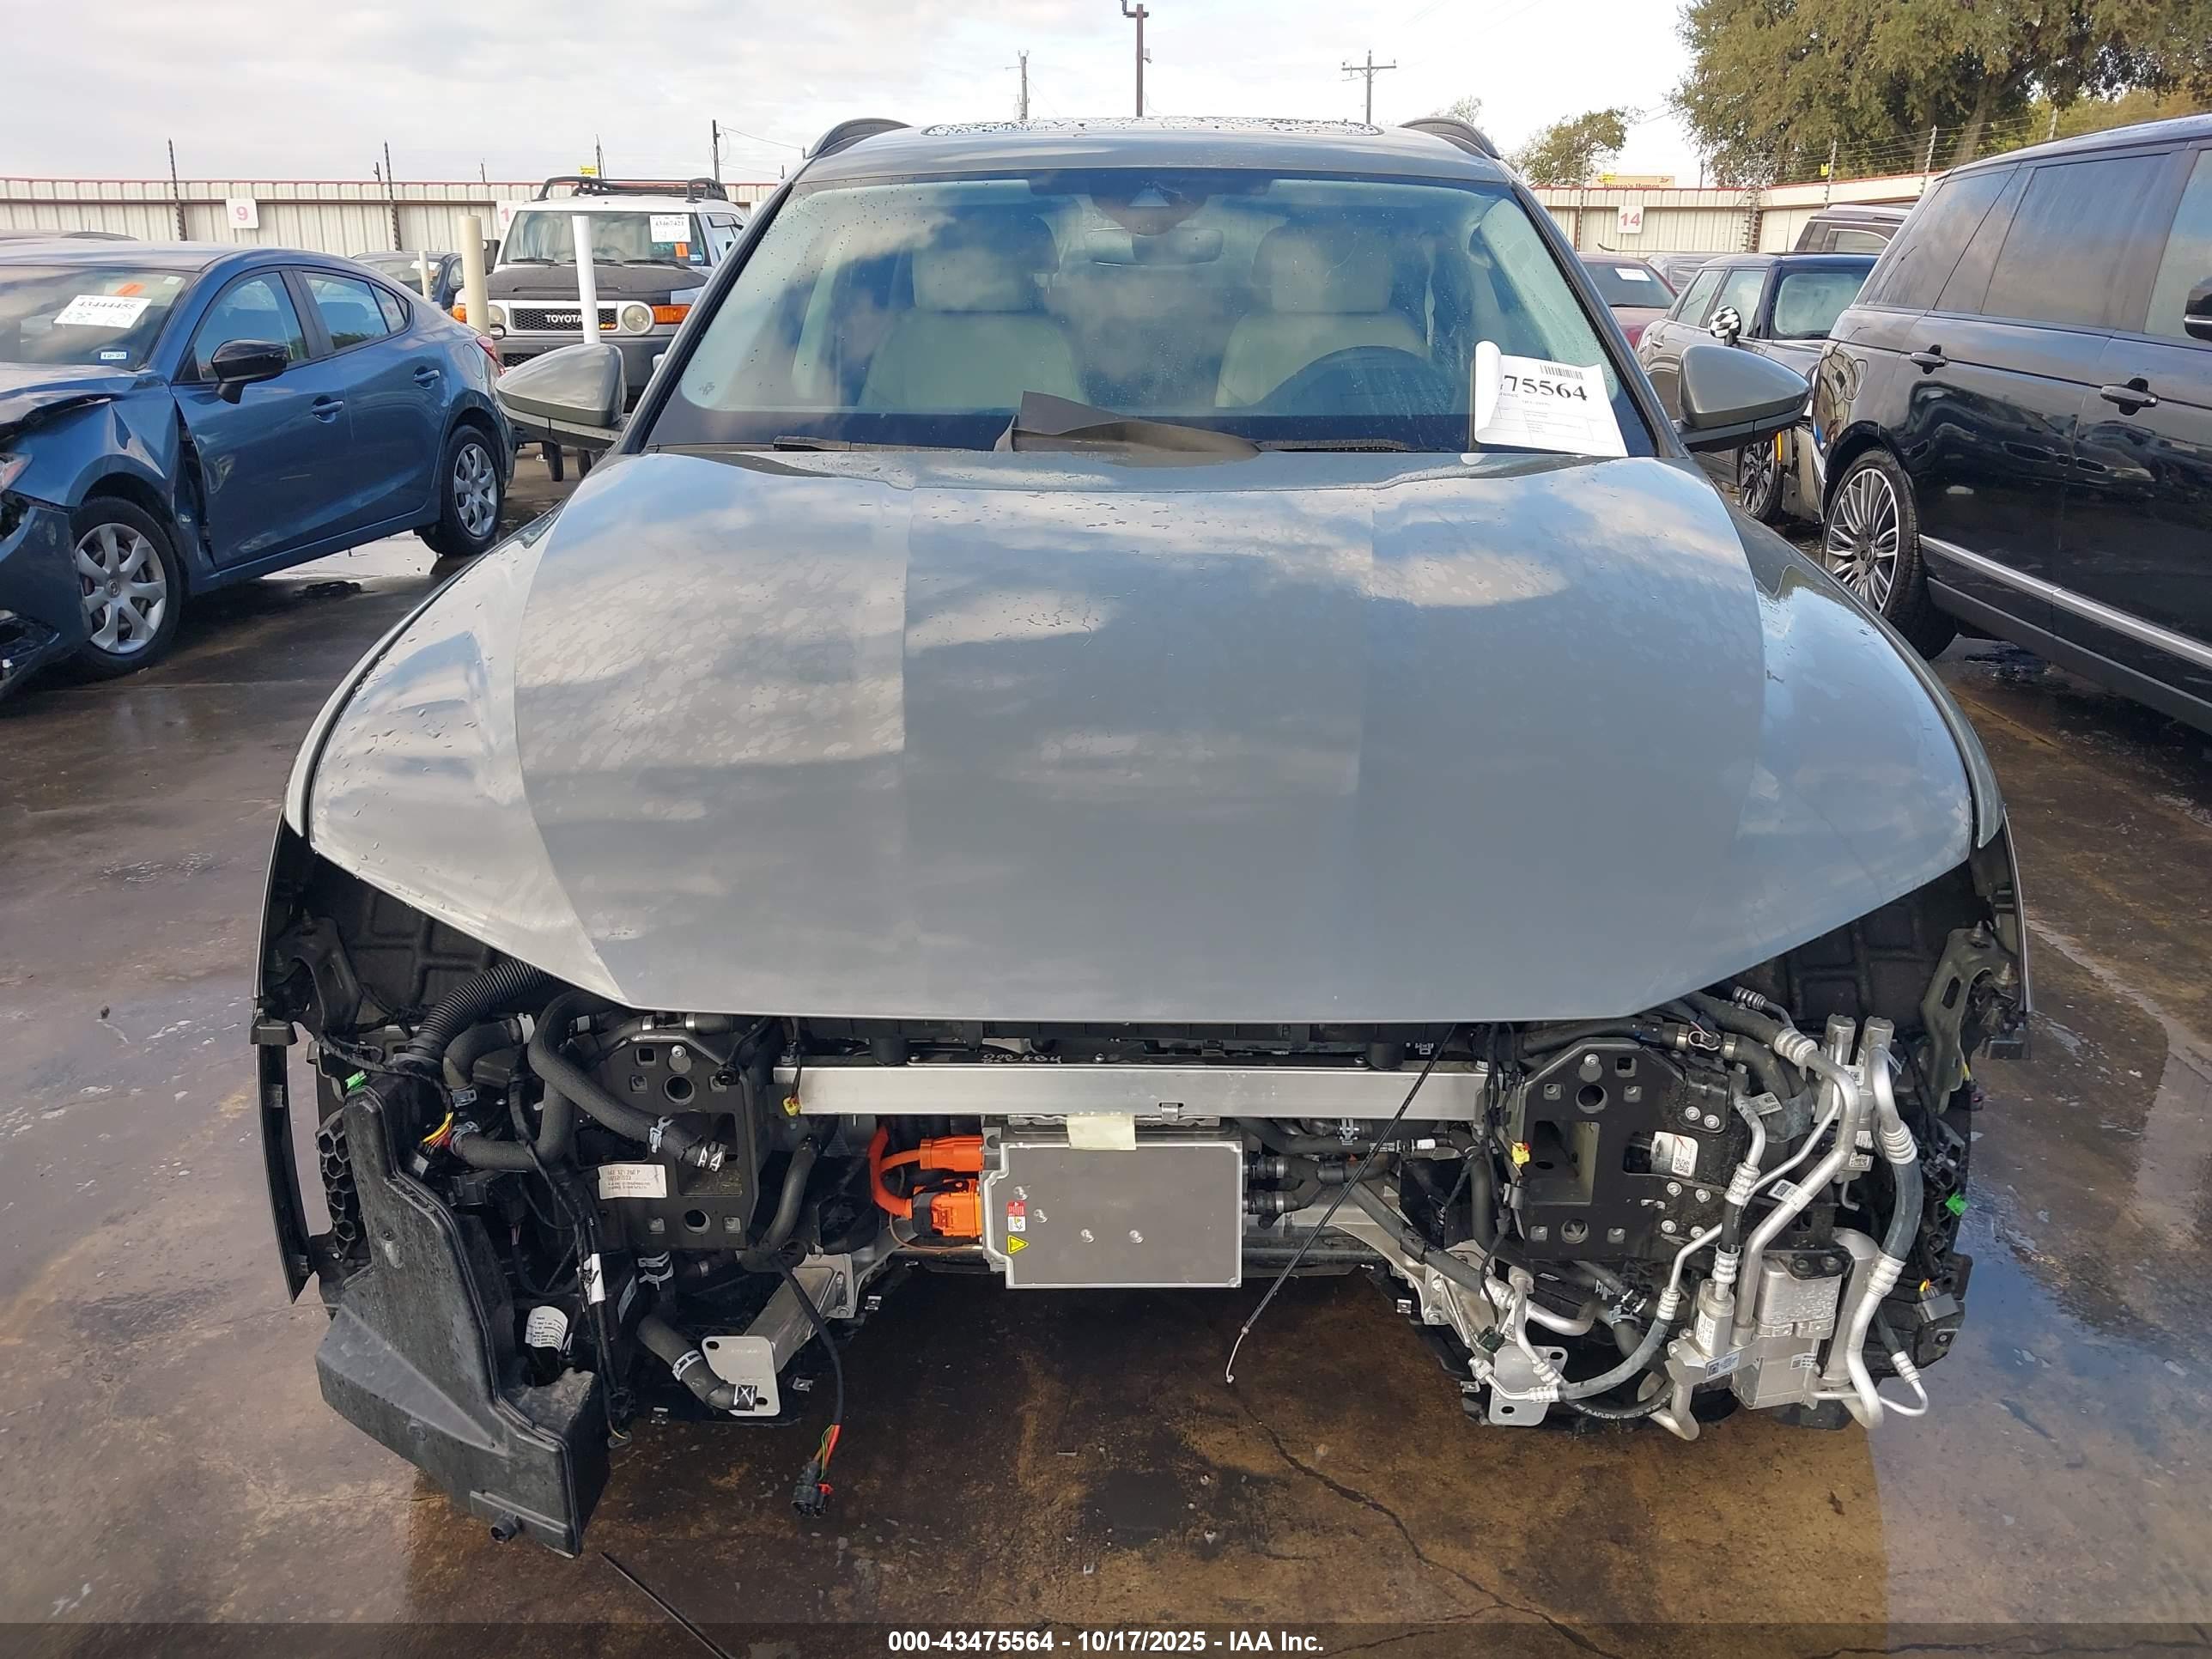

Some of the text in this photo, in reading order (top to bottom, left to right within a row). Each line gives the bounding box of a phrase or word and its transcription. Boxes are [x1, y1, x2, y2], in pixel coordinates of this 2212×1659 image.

[235, 205, 248, 222] 9
[501, 207, 510, 222] 1
[1620, 212, 1642, 227] 14
[544, 314, 583, 324] TOYOTA
[1500, 374, 1588, 402] 75564
